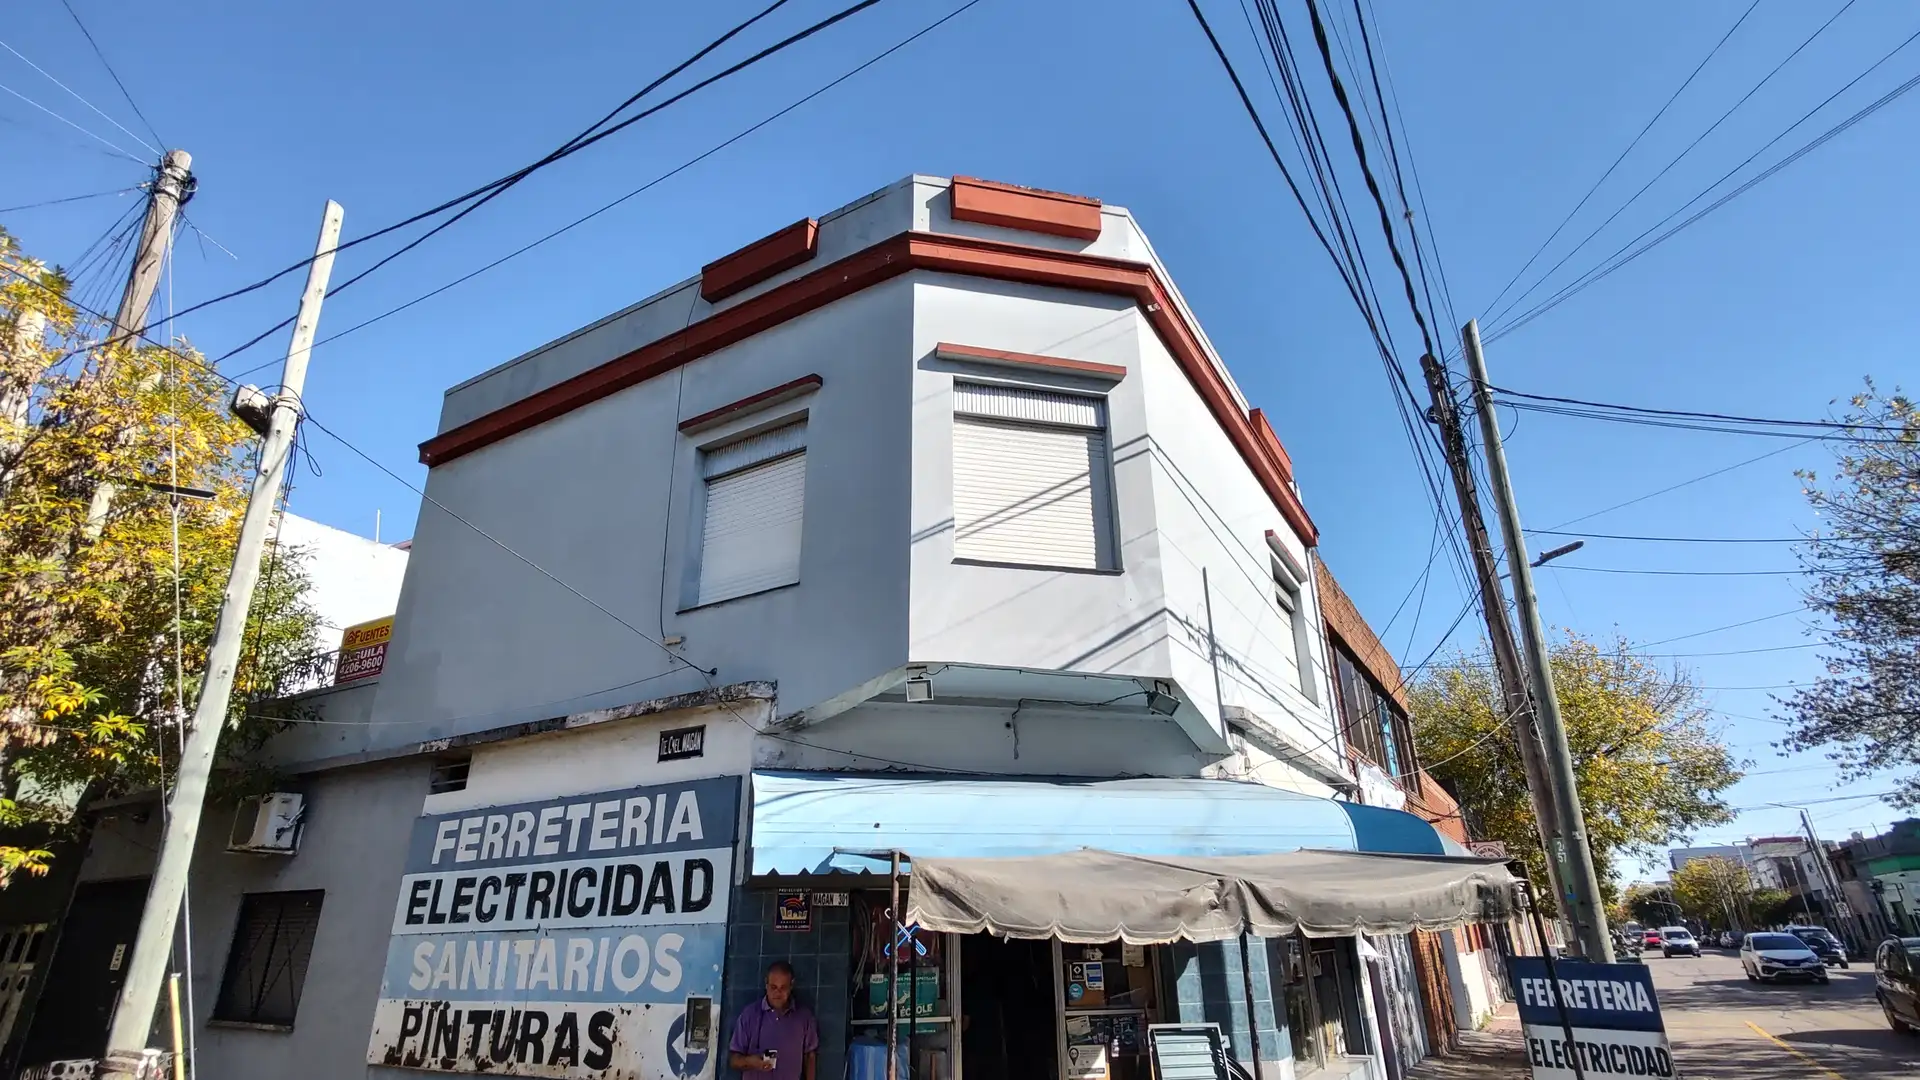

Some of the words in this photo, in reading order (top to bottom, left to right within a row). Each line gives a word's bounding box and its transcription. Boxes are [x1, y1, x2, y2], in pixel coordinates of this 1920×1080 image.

[354, 625, 390, 643] FUENTES
[340, 655, 382, 674] 4206-9600
[431, 790, 703, 864] FERRETERIA
[405, 858, 714, 925] ELECTRICIDAD
[409, 933, 684, 992] SANITARIOS
[396, 1006, 617, 1071] PINTURAS
[1529, 1038, 1673, 1077] ELECTRICIDAD
